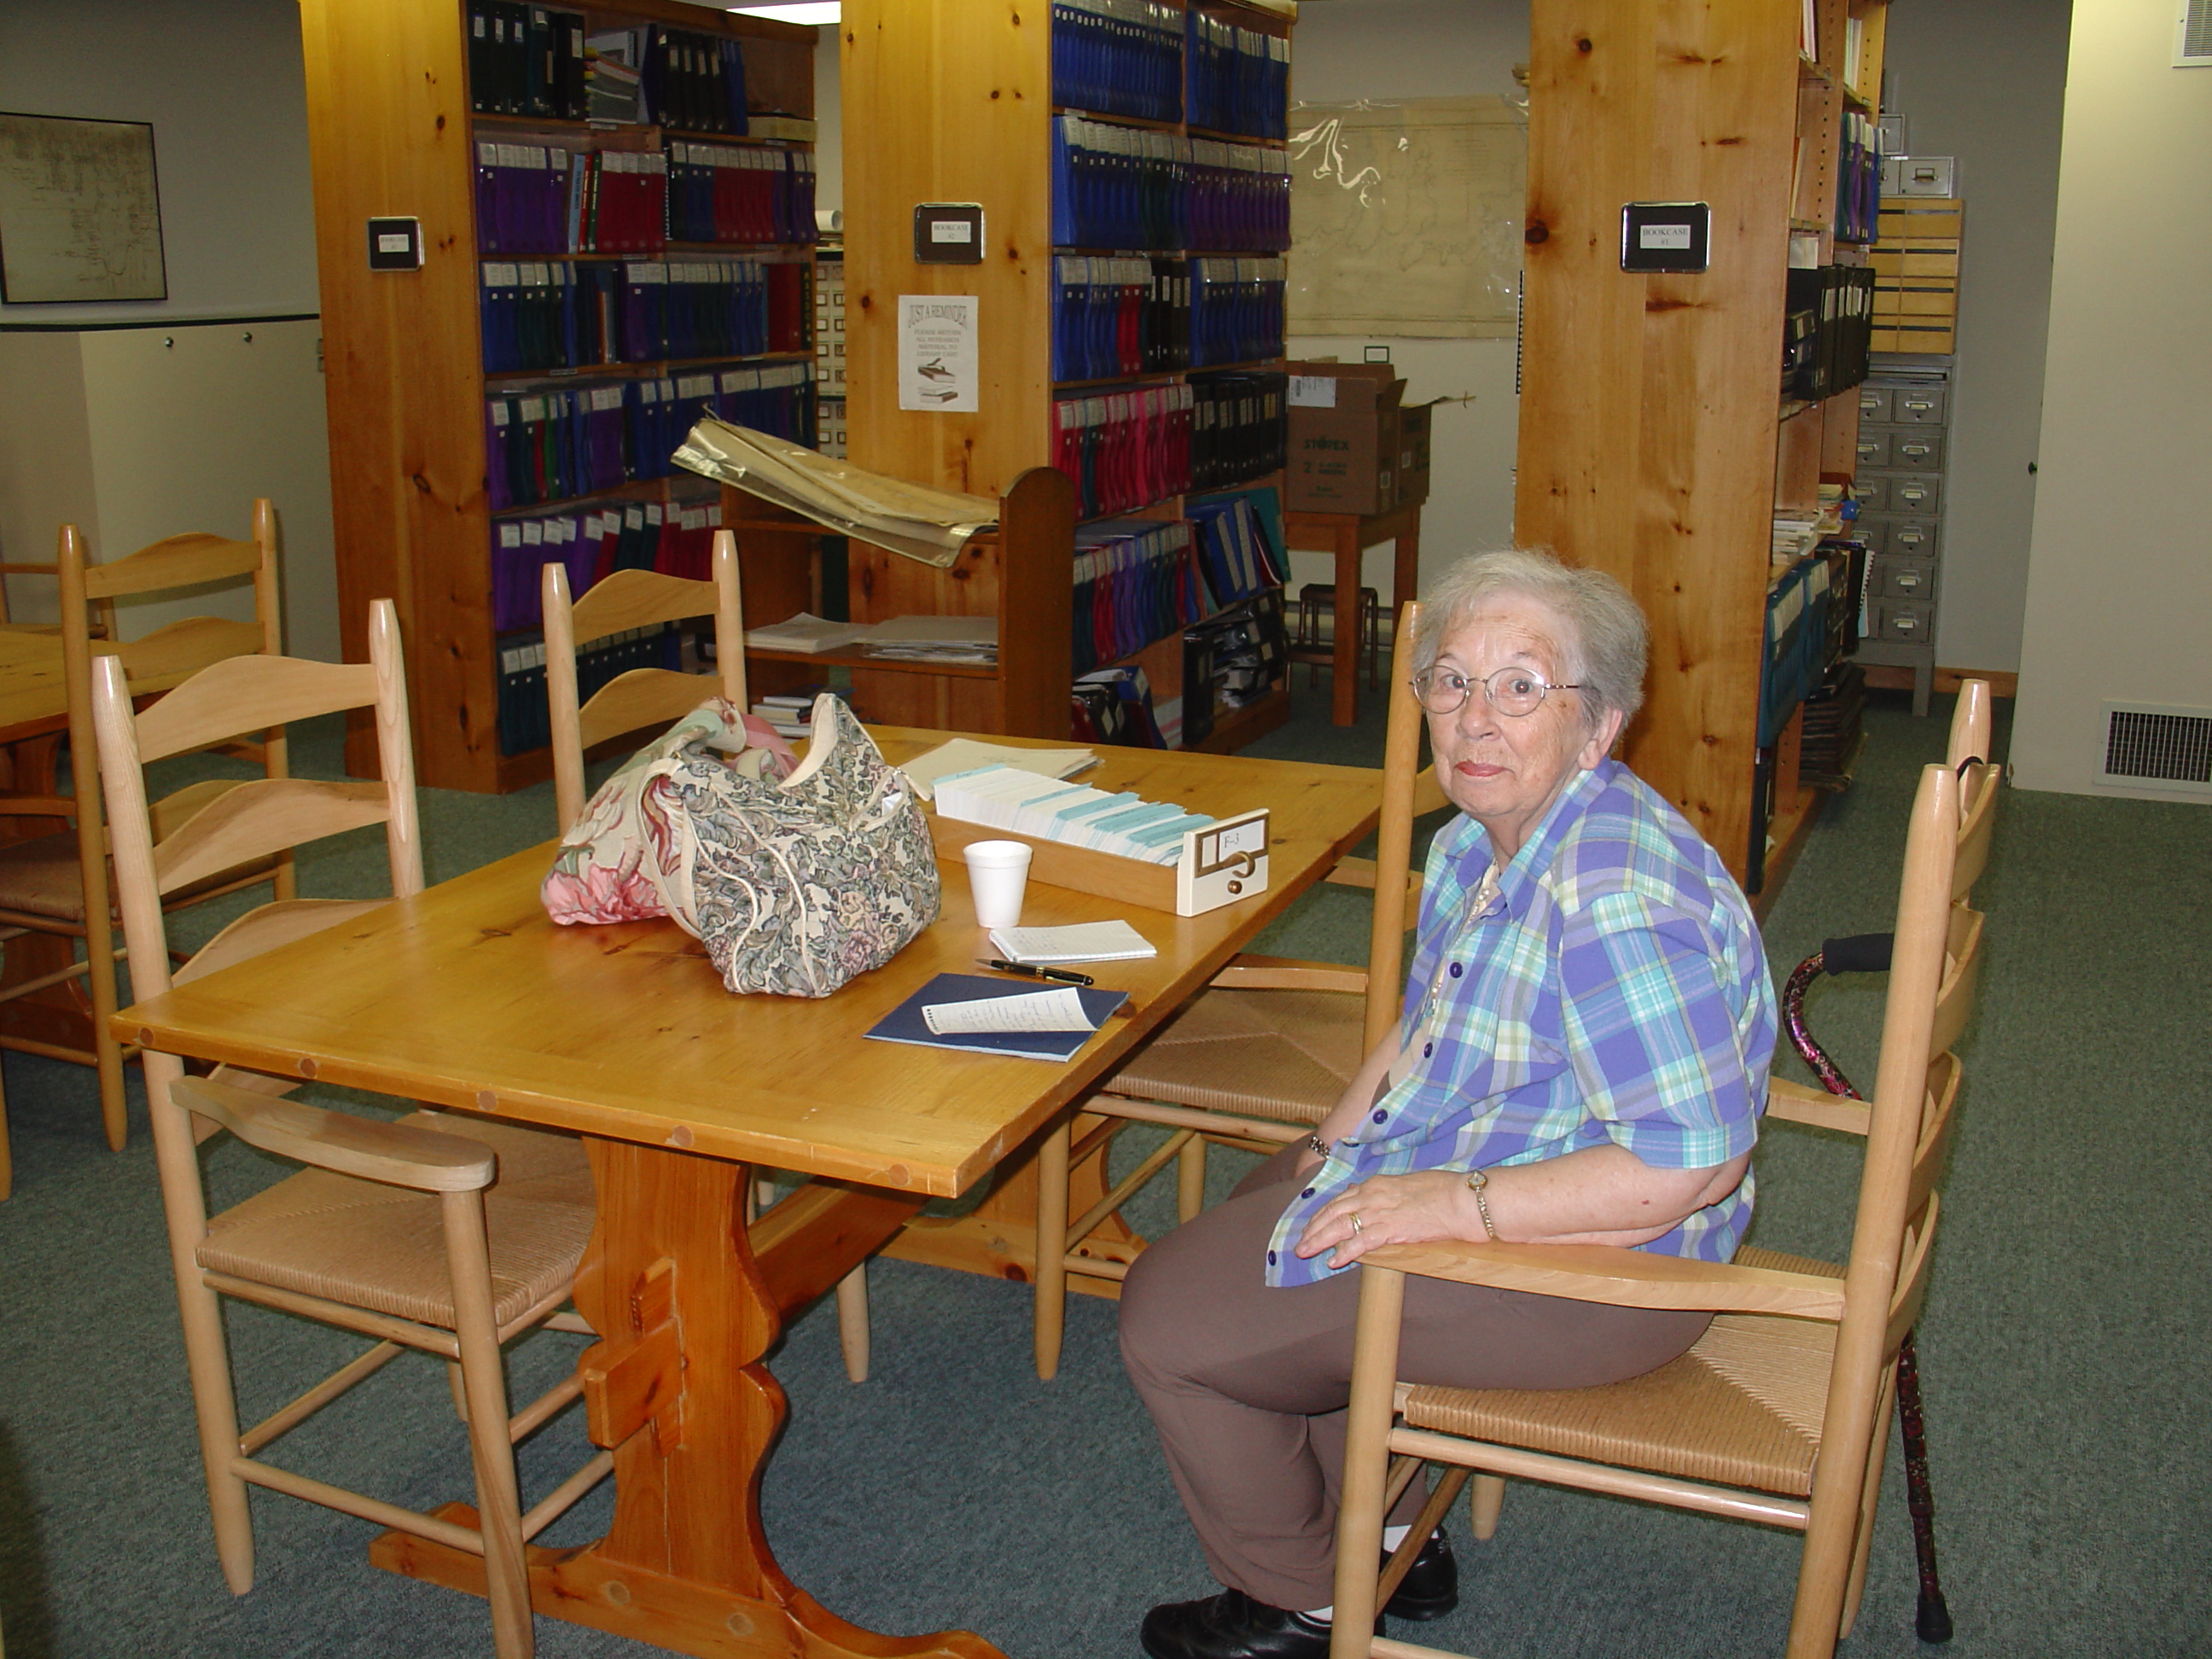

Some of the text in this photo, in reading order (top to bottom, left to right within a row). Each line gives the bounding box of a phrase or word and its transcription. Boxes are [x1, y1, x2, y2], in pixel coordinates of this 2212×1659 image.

[908, 305, 967, 330] JUST A REMINDER
